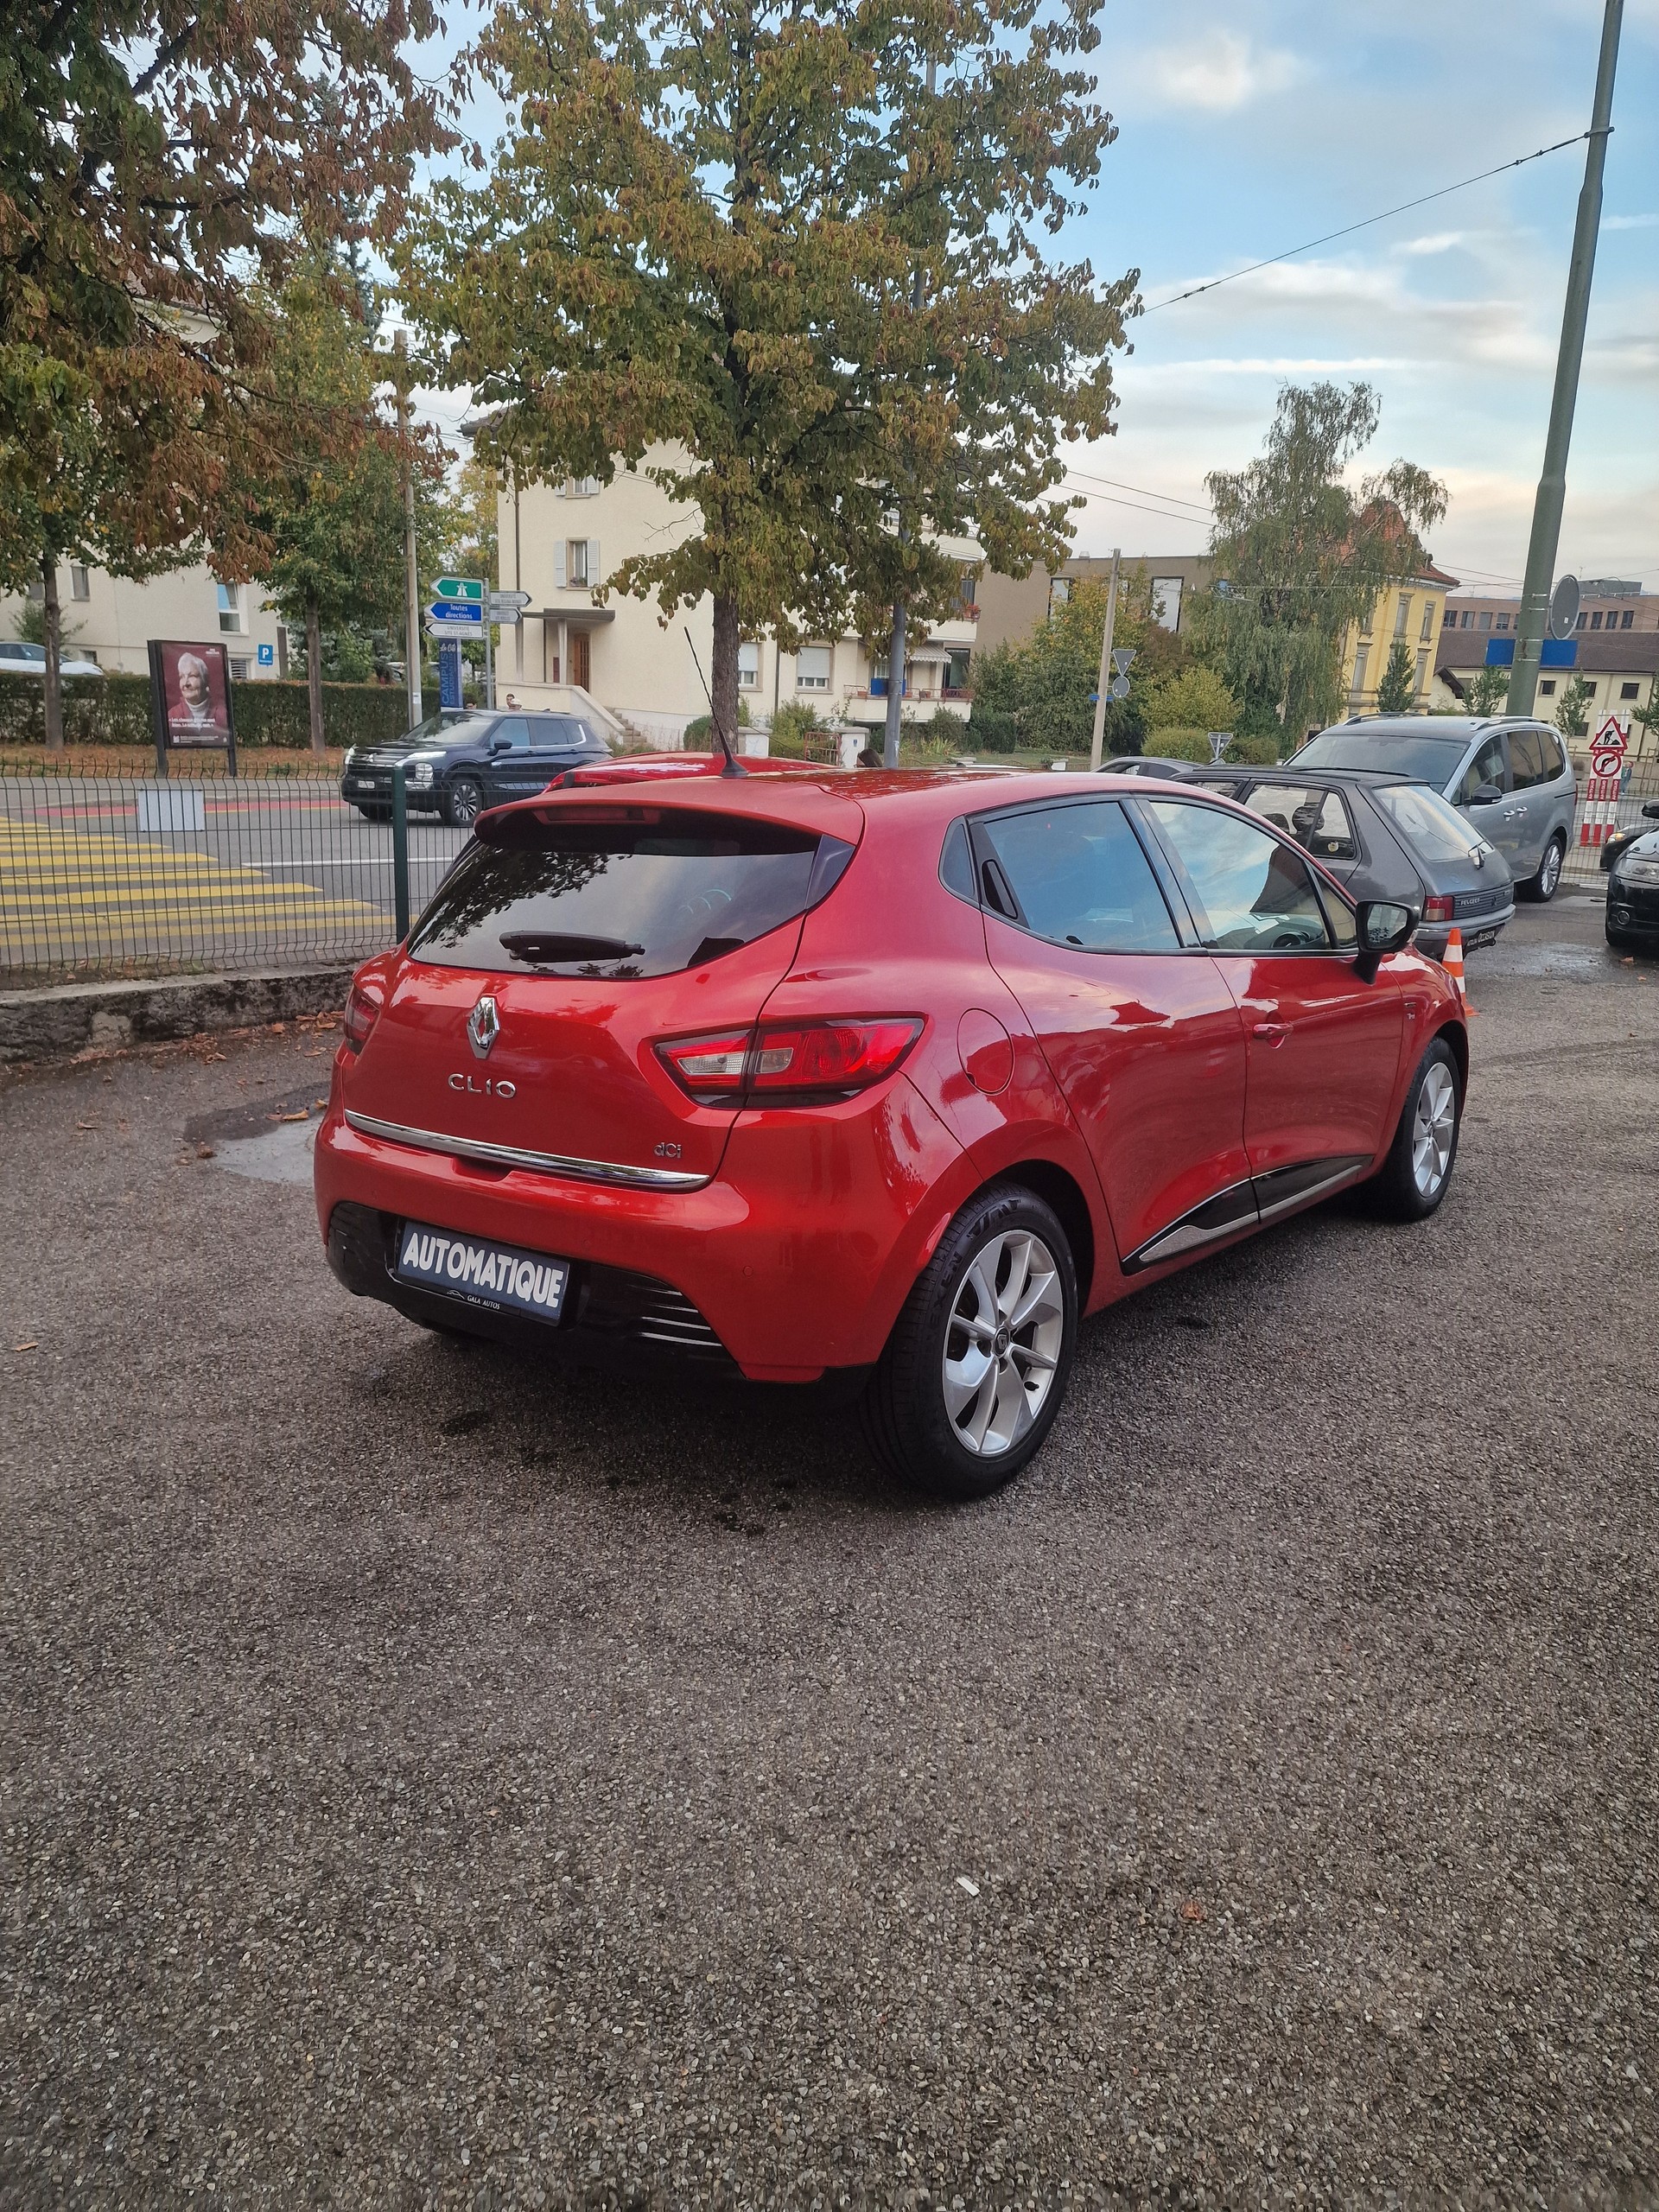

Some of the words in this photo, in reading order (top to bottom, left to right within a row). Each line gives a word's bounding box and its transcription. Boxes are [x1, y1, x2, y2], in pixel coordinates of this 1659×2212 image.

[262, 647, 270, 659] P
[441, 652, 449, 704] CAMPUS
[448, 1073, 516, 1098] CLIO
[654, 1141, 682, 1159] dCi
[403, 1232, 563, 1308] AUTOMATIQUE
[467, 1294, 480, 1304] GALA
[482, 1300, 500, 1310] AUTOS
